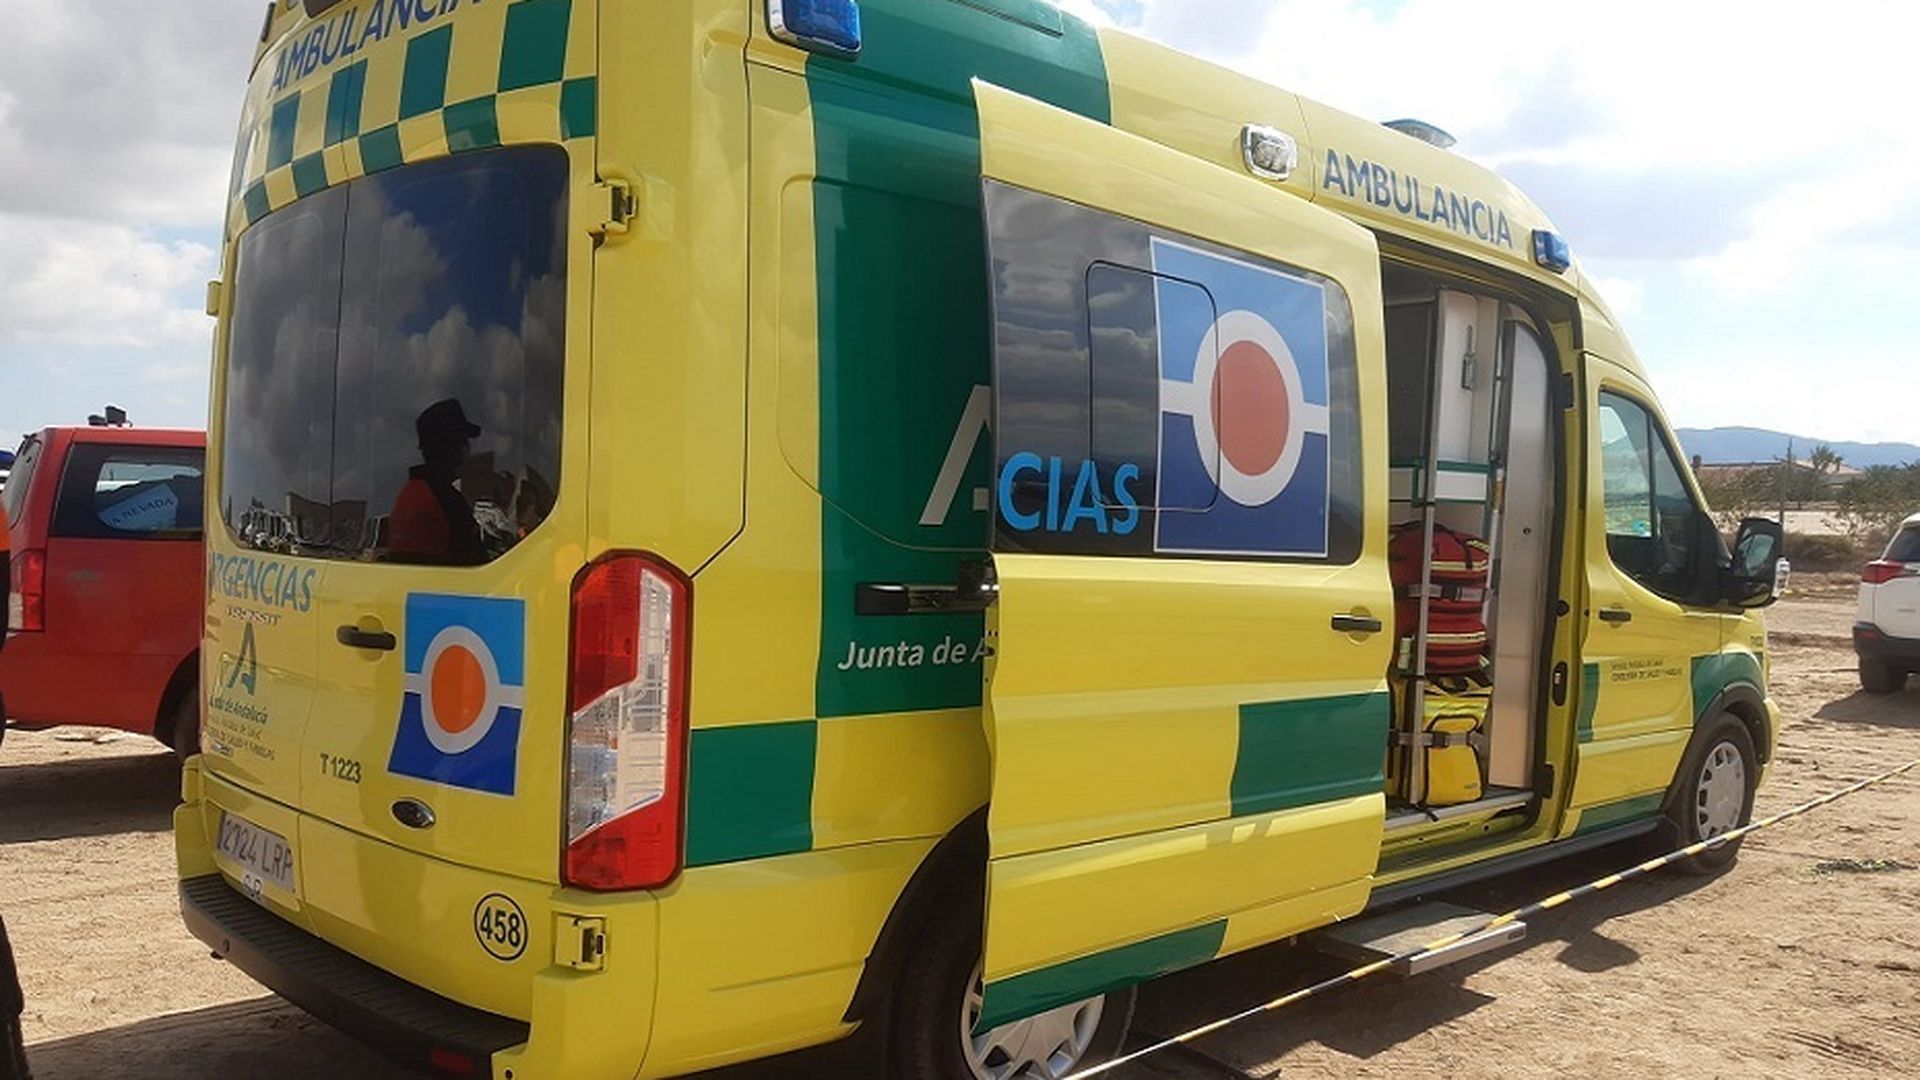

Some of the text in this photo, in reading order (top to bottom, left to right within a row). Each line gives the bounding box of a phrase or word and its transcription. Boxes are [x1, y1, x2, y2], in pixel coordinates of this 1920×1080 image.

[270, 0, 480, 91] AMBULANC
[1323, 148, 1514, 249] AMBULANCIA
[998, 451, 1140, 536] CIAS
[838, 640, 923, 671] Junta
[933, 635, 967, 664] de
[319, 752, 362, 784] T 1223
[262, 837, 294, 881] LRP
[479, 905, 521, 948] 458
